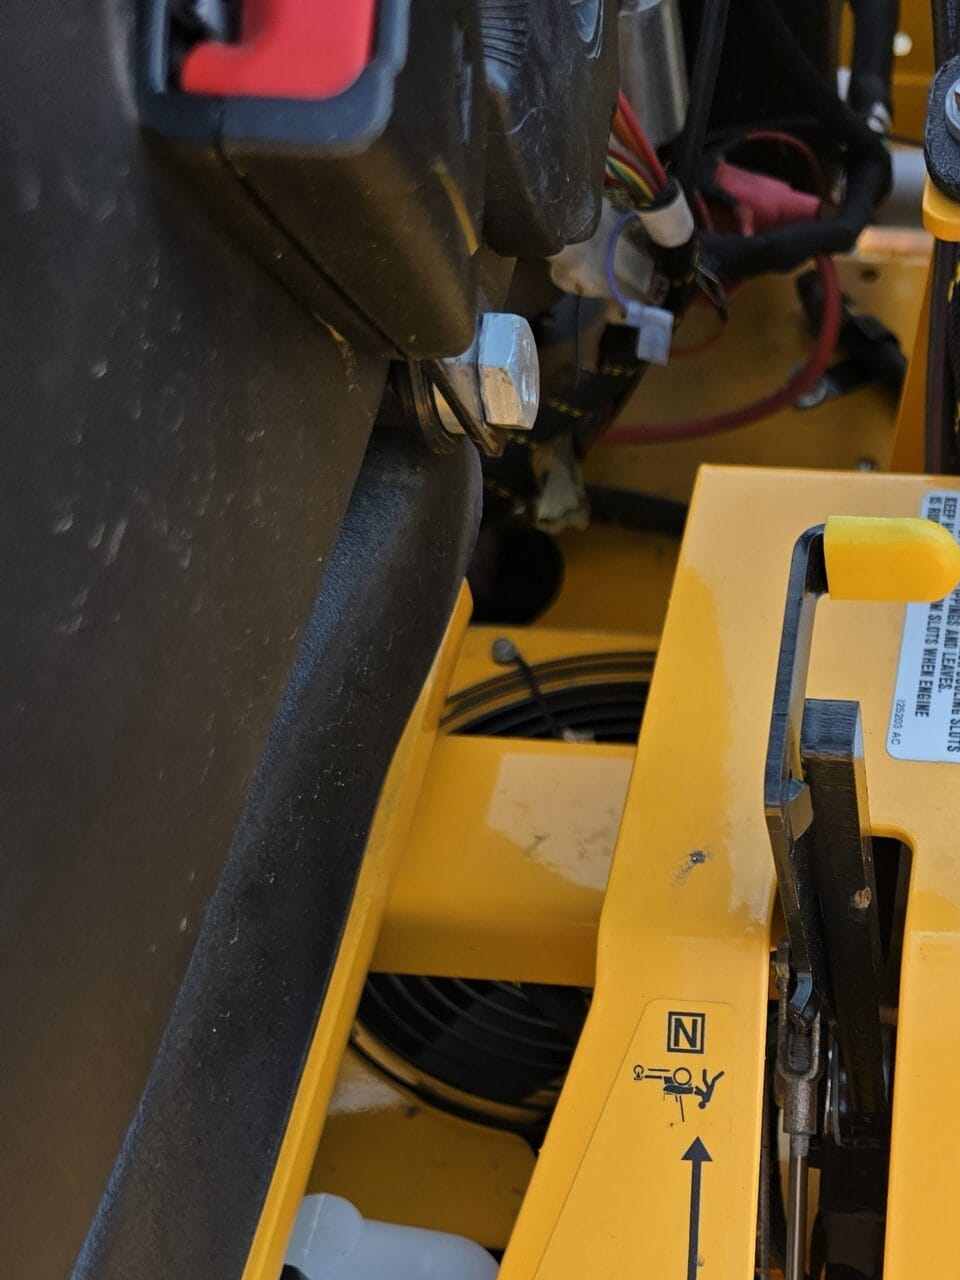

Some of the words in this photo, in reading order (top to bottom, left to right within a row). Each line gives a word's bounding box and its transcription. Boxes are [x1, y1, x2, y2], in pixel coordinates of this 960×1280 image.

[943, 497, 957, 520] KEEP
[925, 615, 942, 645] SLOTS
[944, 629, 959, 649] AND
[920, 648, 938, 677] WHEN
[938, 652, 956, 693] LEAVES.
[915, 680, 933, 717] ENGINE
[893, 700, 905, 729] 125203
[891, 732, 901, 745] AC
[673, 1017, 698, 1048] N
